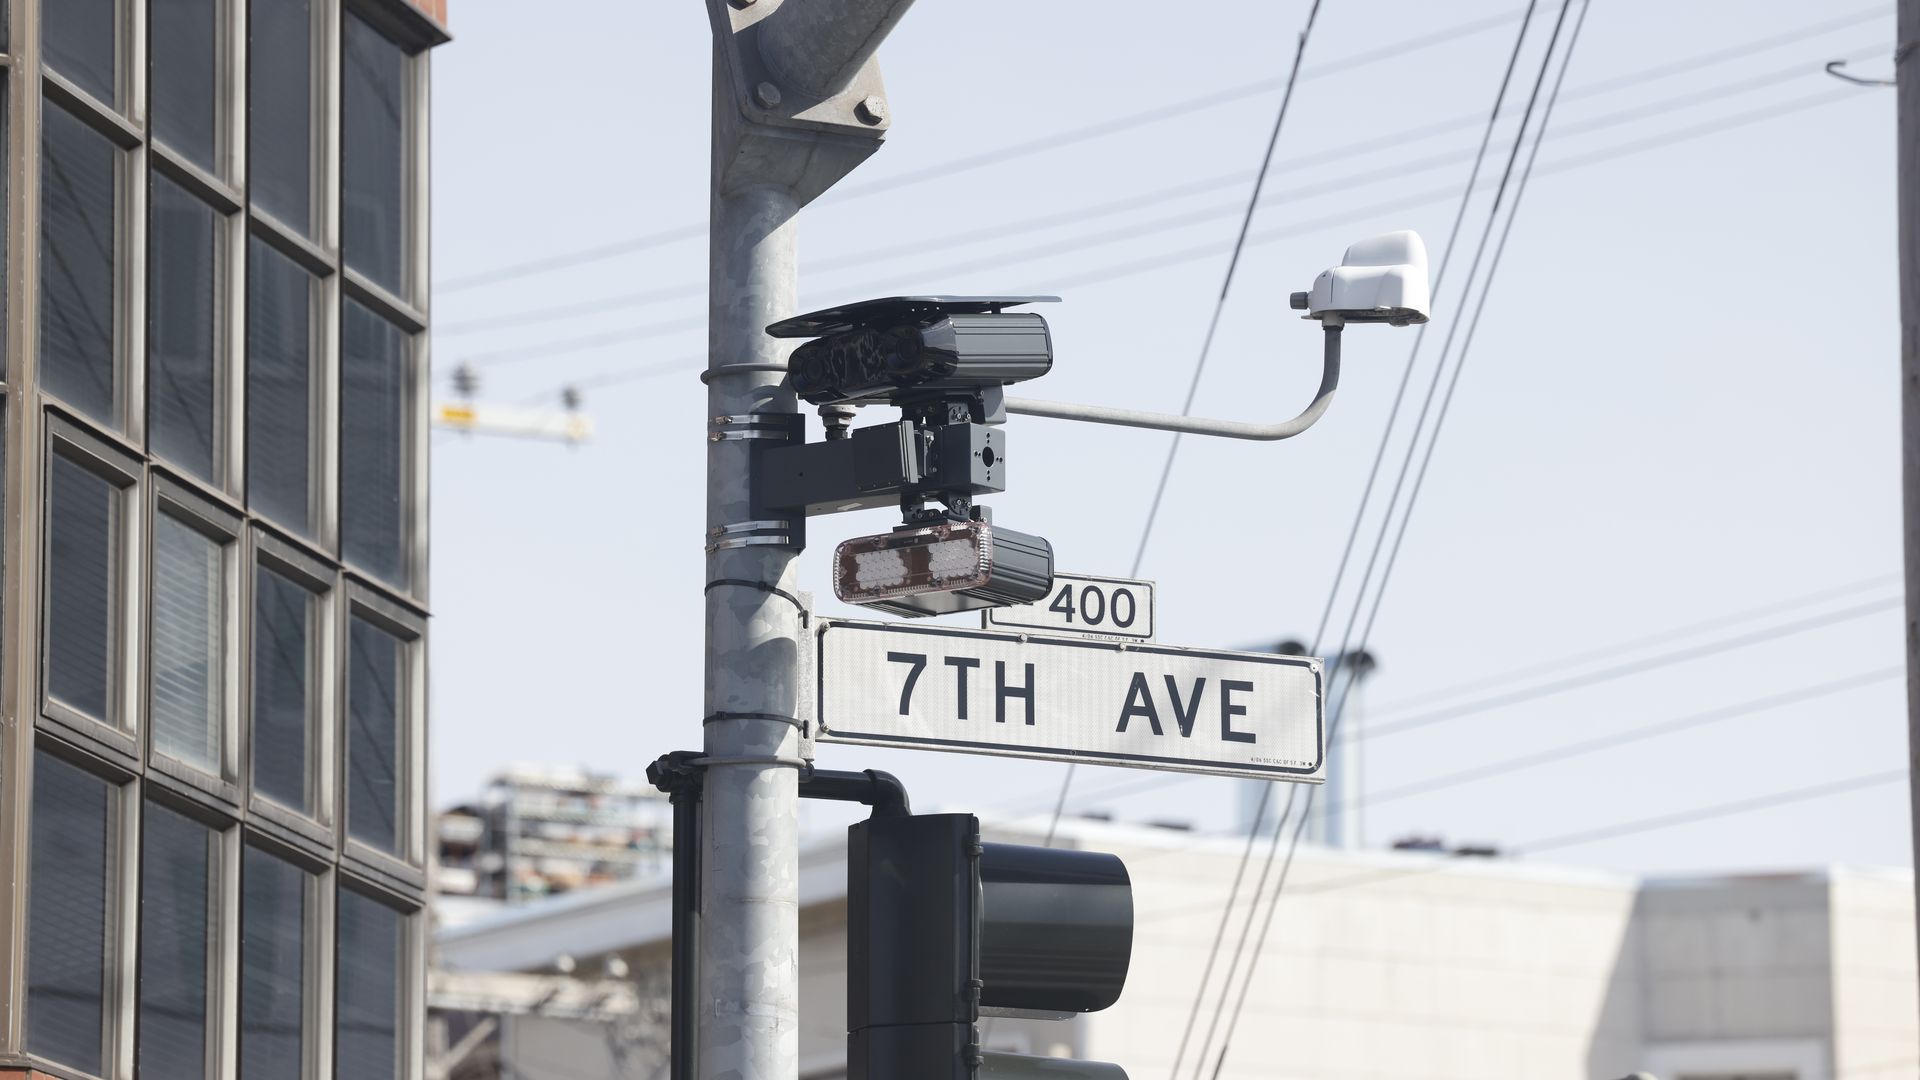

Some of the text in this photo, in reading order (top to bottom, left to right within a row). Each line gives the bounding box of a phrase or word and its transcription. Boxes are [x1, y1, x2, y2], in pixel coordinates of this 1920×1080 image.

[1049, 583, 1136, 629] 400
[887, 651, 1257, 744] 7TH AVE
